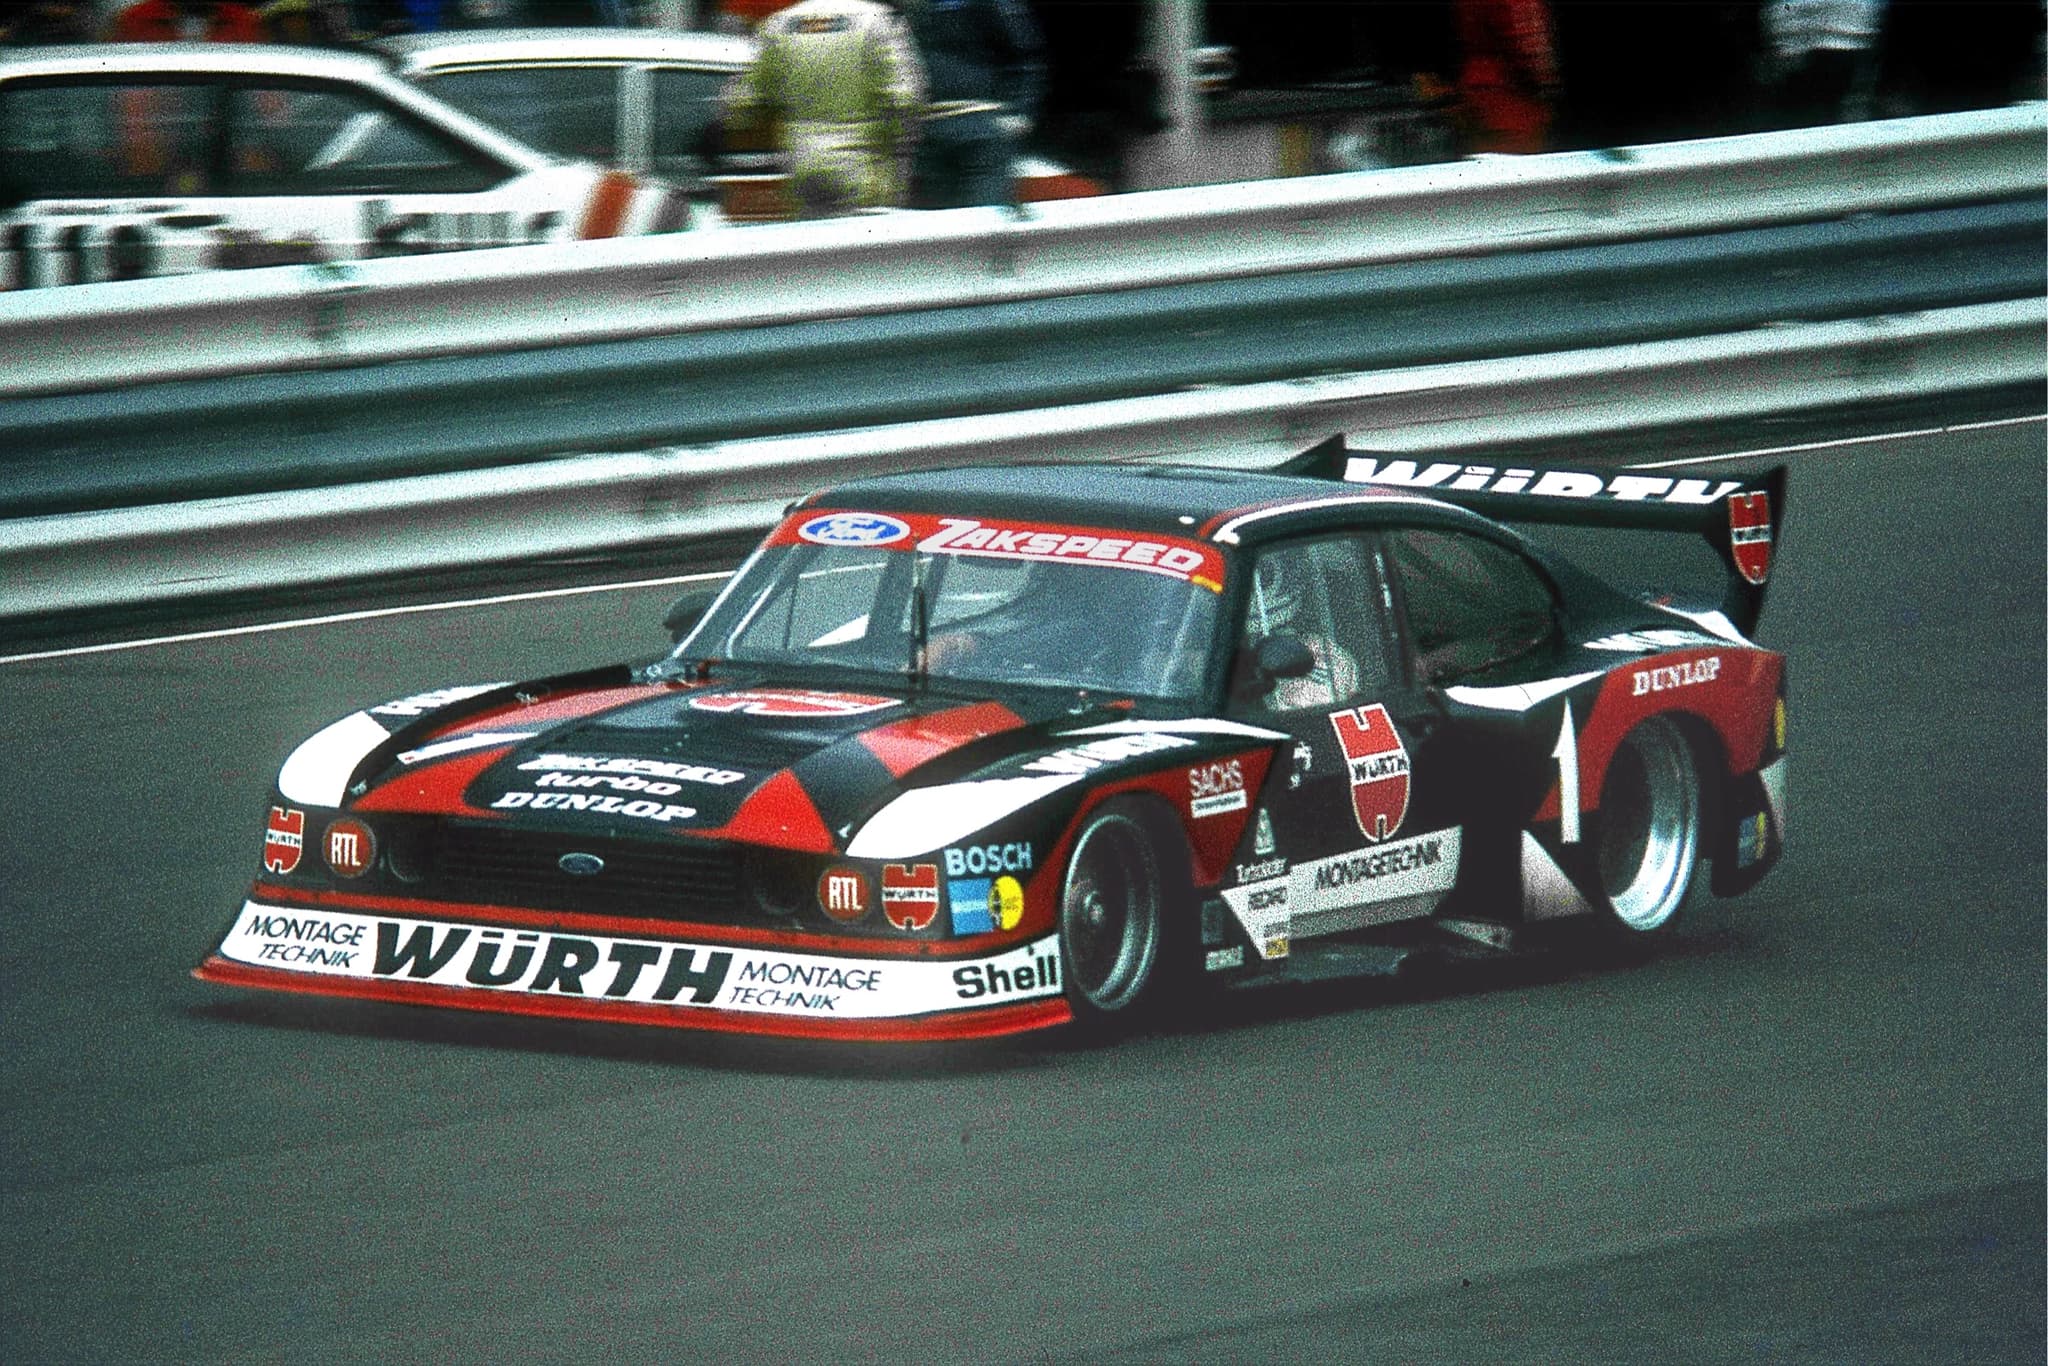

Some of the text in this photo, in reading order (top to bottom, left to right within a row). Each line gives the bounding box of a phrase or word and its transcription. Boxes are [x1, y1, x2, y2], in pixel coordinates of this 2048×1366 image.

[917, 519, 1205, 577] ZAKSPEED
[1632, 657, 1722, 696] DUNLOP
[535, 772, 682, 796] turbo
[1190, 760, 1244, 797] SACHS
[1551, 696, 1581, 844] 1
[491, 792, 697, 821] DUNLOP
[331, 832, 361, 867] RTL
[944, 842, 1033, 877] BOSCH
[828, 875, 863, 912] RTL
[244, 915, 367, 947] MONTAGE
[258, 943, 360, 969] TECHNIK
[372, 921, 734, 1004] WÜRTH
[739, 961, 882, 992] MONTAGE
[953, 954, 1057, 999] Shell
[729, 986, 840, 1011] TECHNIK
